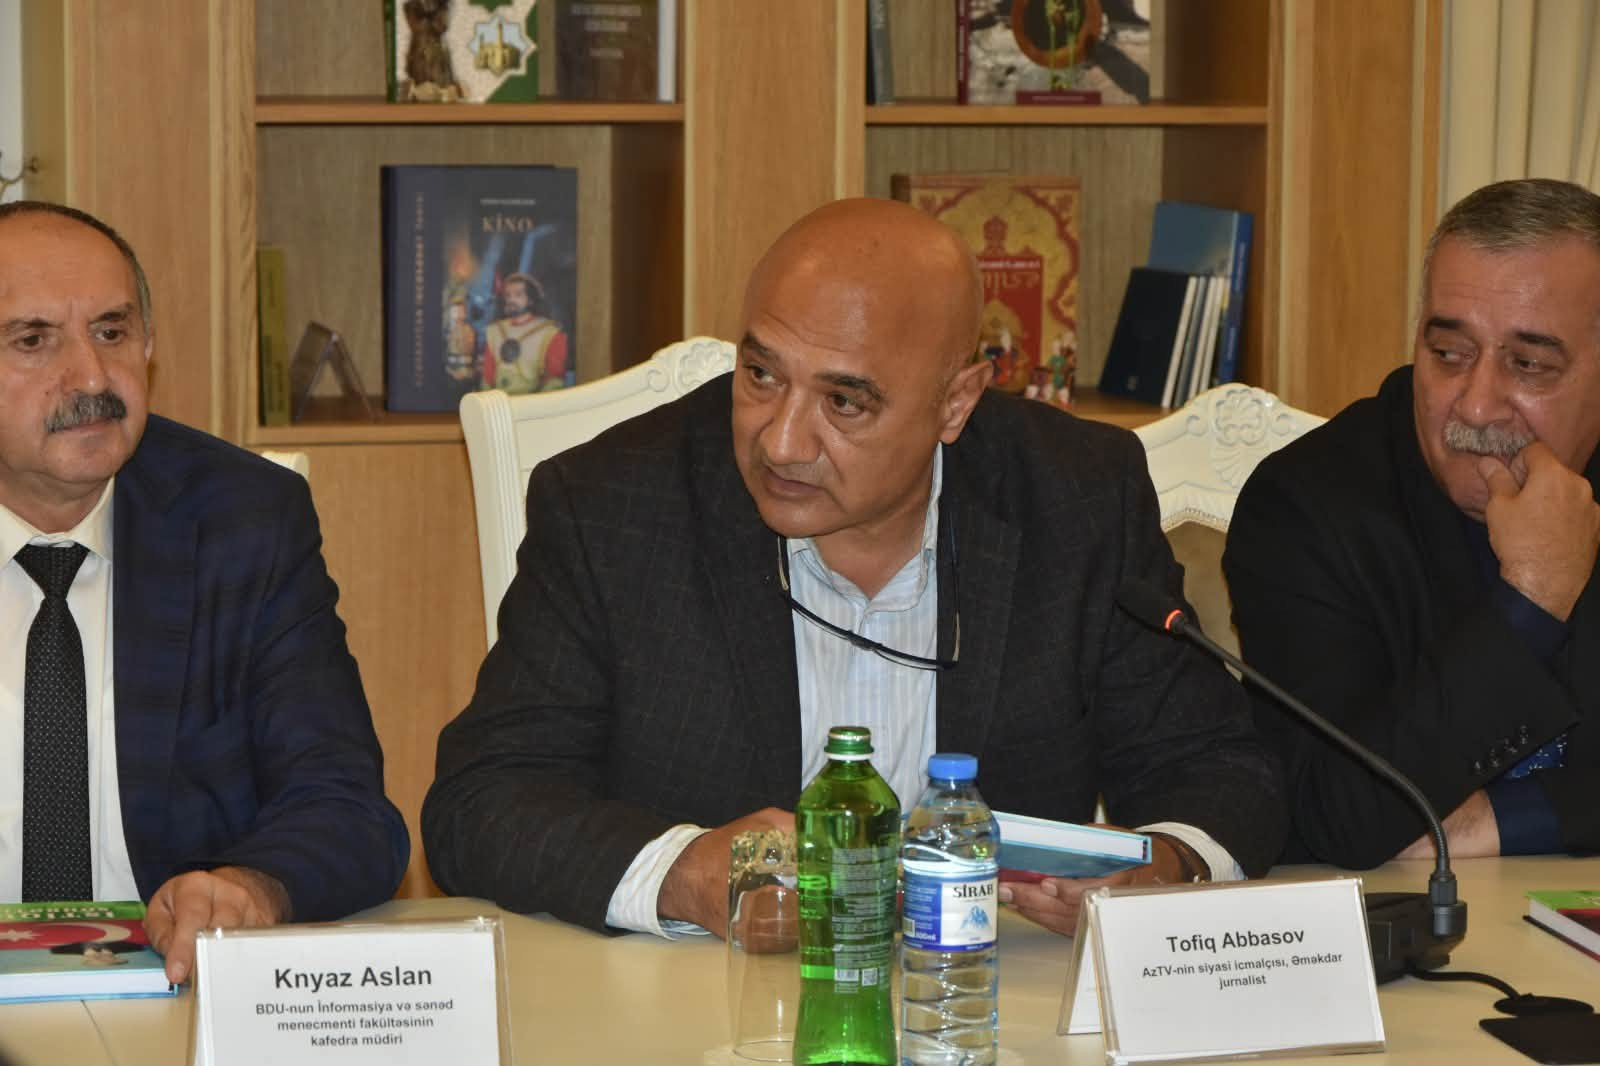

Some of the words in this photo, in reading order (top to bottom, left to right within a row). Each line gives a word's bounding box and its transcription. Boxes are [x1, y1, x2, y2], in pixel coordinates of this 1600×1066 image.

[952, 883, 994, 898] SİRAB
[1166, 934, 1217, 954] Tofiq
[1222, 930, 1305, 949] Abbasov
[1142, 964, 1195, 978] AzTV-nin
[1198, 961, 1232, 976] siyasi
[1291, 953, 1343, 966] Əməkdar
[274, 968, 353, 994] Knyaz
[360, 966, 432, 987] Aslan
[1219, 975, 1267, 990] jurnalist
[256, 1003, 314, 1015] BDU-nun
[317, 999, 393, 1014] İnformasiya
[396, 1003, 412, 1012] və
[415, 998, 454, 1011] sənəd
[277, 1018, 356, 1031] menecmenti
[359, 1016, 434, 1029] fakültəsinin
[311, 1034, 358, 1048] kafedra
[362, 1033, 403, 1046] müdiri
